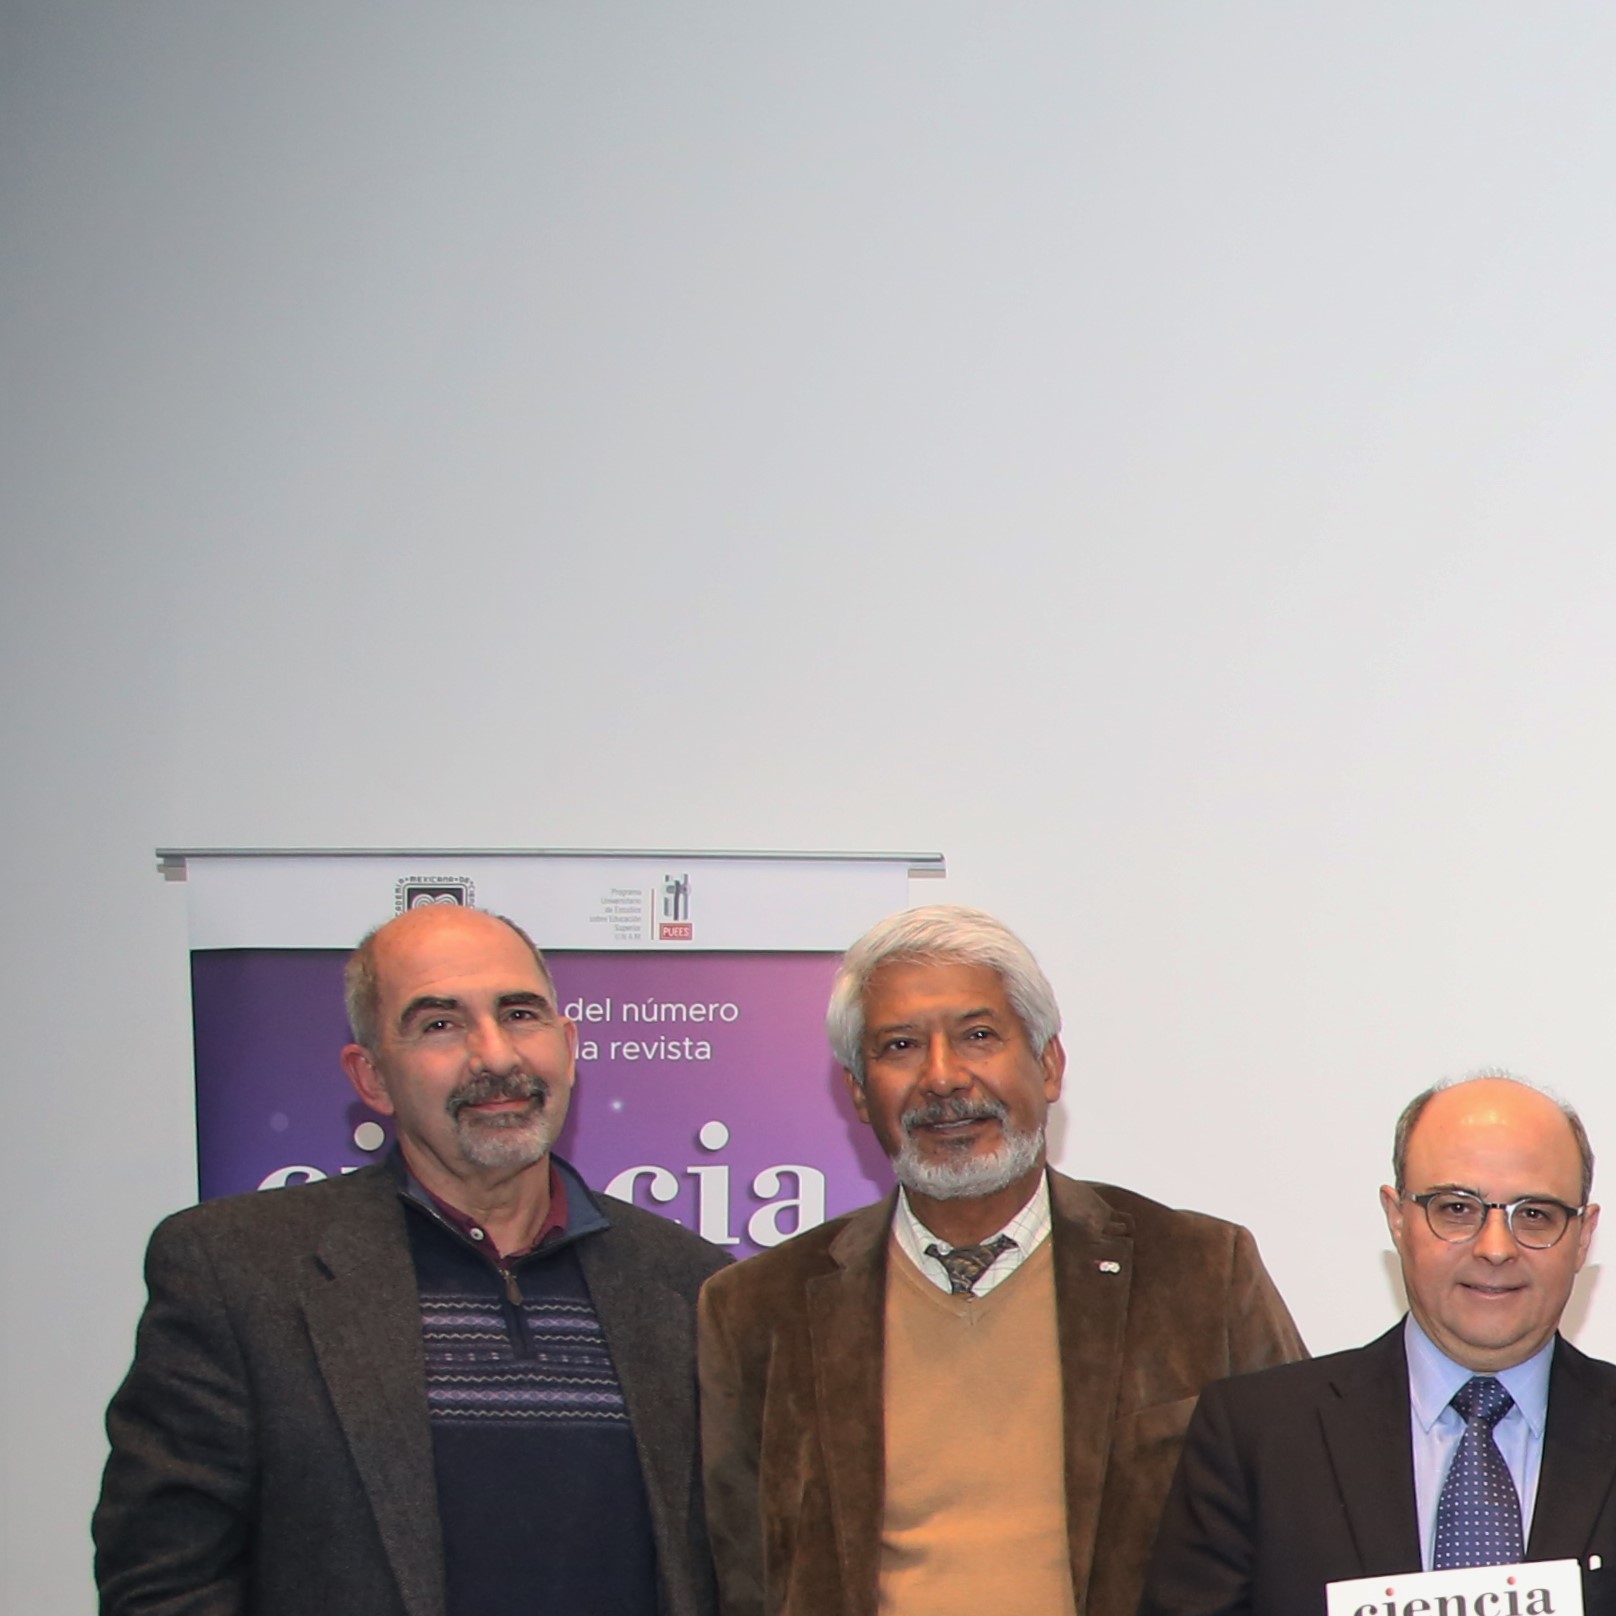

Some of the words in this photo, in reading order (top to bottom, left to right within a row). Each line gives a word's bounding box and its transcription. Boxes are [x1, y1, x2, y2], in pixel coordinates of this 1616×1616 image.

[663, 927, 690, 937] PUEES
[564, 998, 611, 1022] del
[622, 997, 739, 1022] número
[610, 1035, 712, 1060] revista
